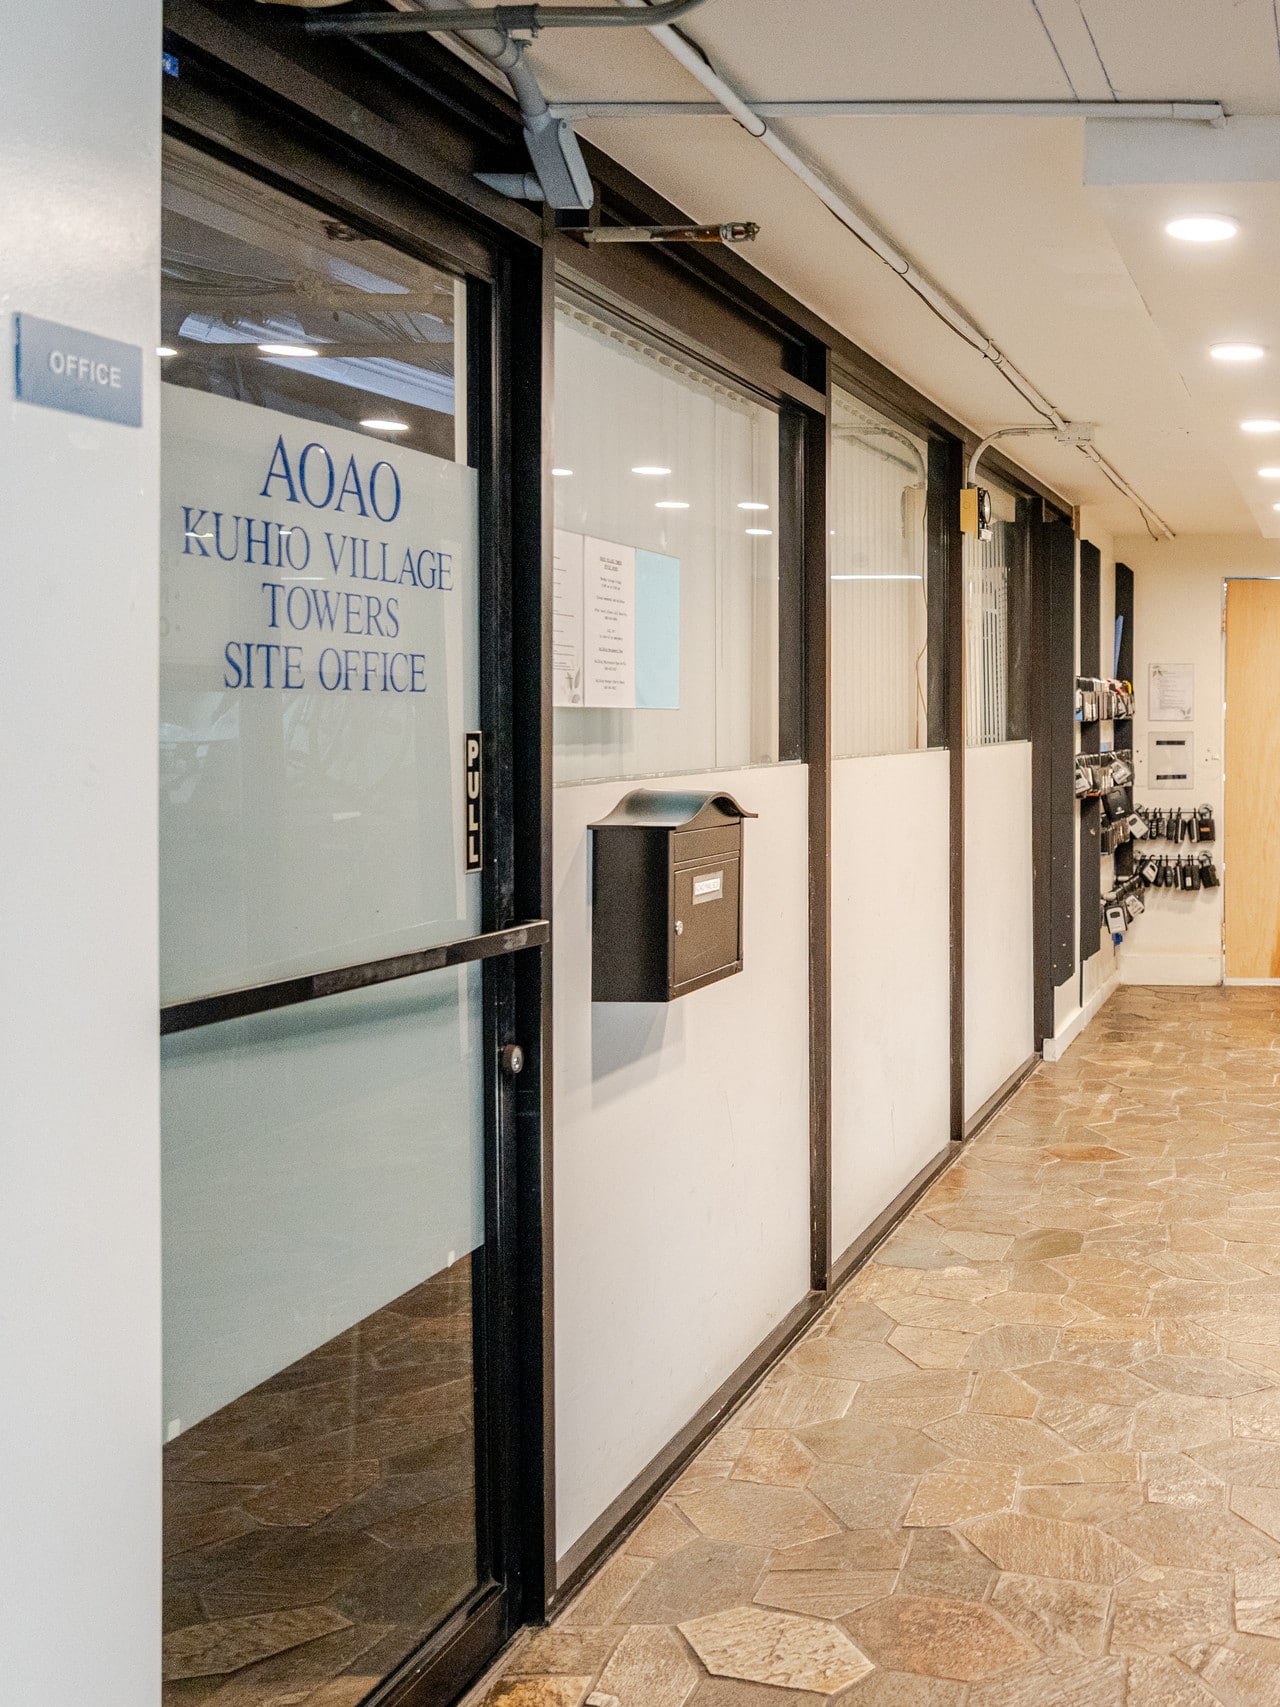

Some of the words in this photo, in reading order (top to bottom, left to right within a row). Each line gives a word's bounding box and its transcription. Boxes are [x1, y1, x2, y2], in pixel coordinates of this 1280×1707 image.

[49, 351, 122, 389] OFFICE
[260, 435, 401, 523] AOAO
[181, 506, 310, 571] KUHIO
[325, 532, 454, 592] VILLAGE
[262, 583, 400, 639] TOWERS
[224, 642, 305, 690] SITE
[319, 647, 427, 693] OFFICE
[468, 739, 479, 863] PULL
